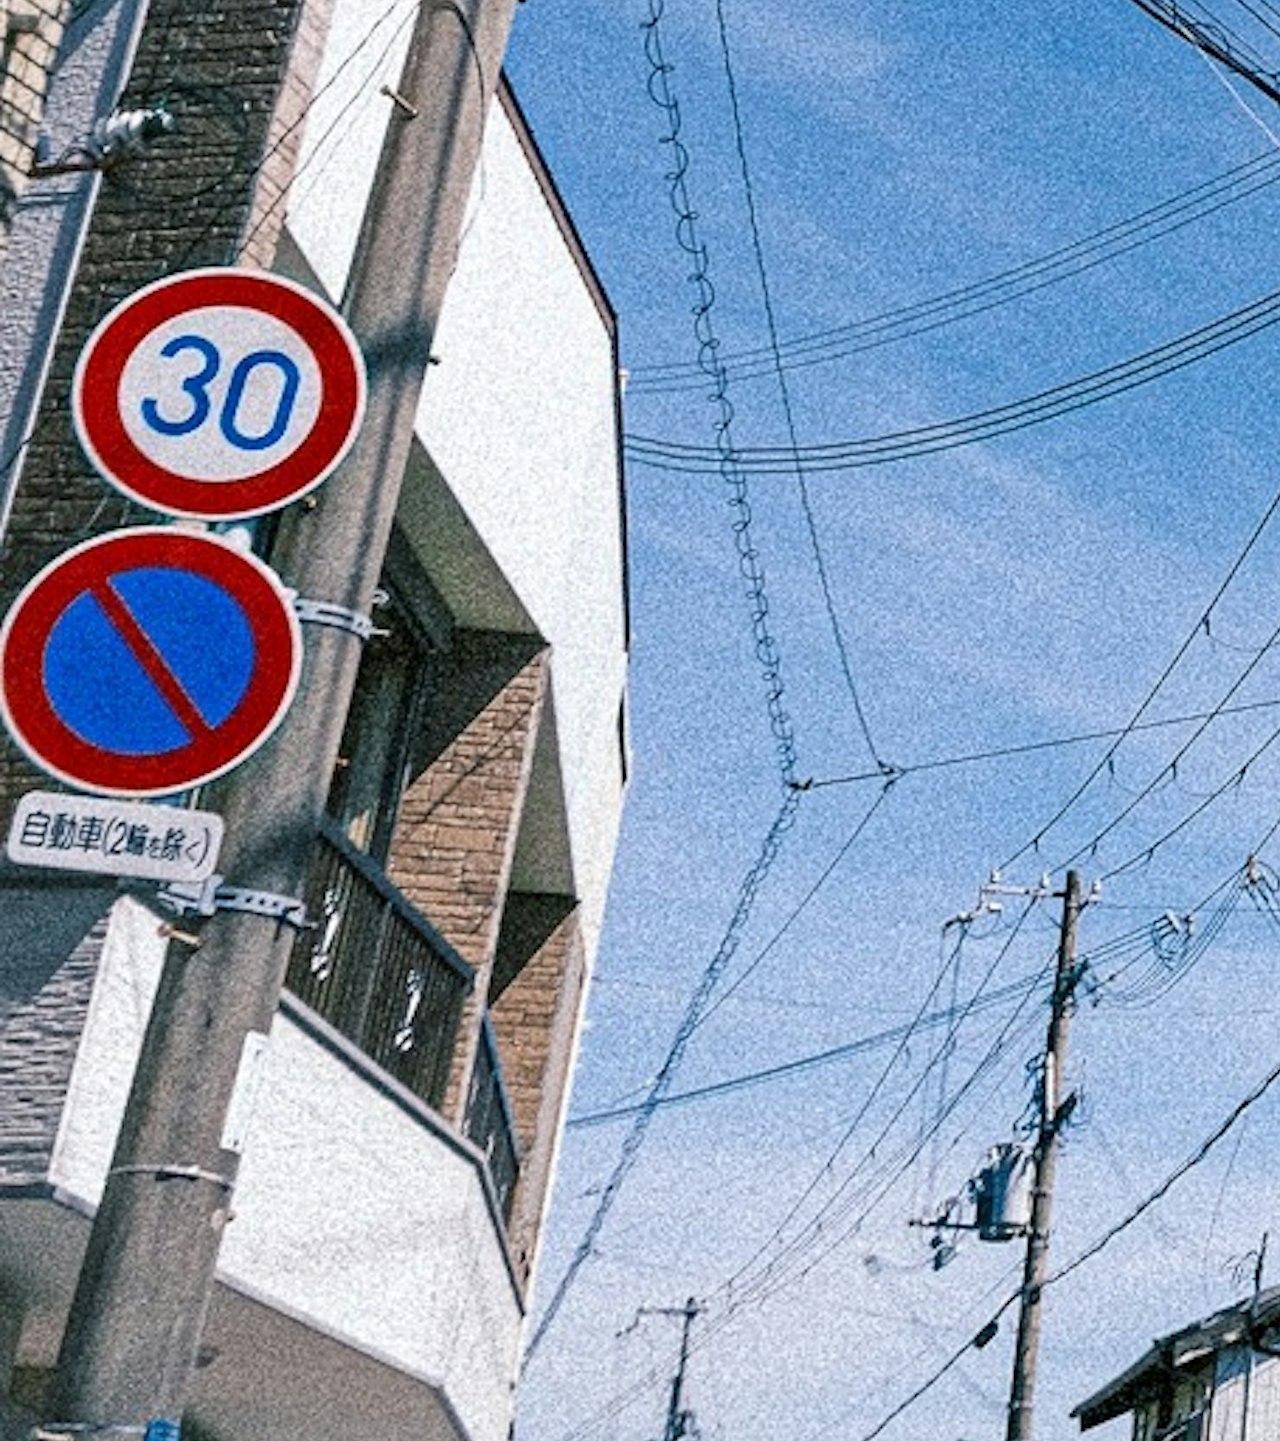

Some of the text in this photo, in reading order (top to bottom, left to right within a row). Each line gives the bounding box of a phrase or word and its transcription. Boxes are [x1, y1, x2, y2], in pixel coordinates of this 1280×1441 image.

[141, 335, 300, 450] 30
[19, 811, 210, 868] 自動車(2輪を除く)
